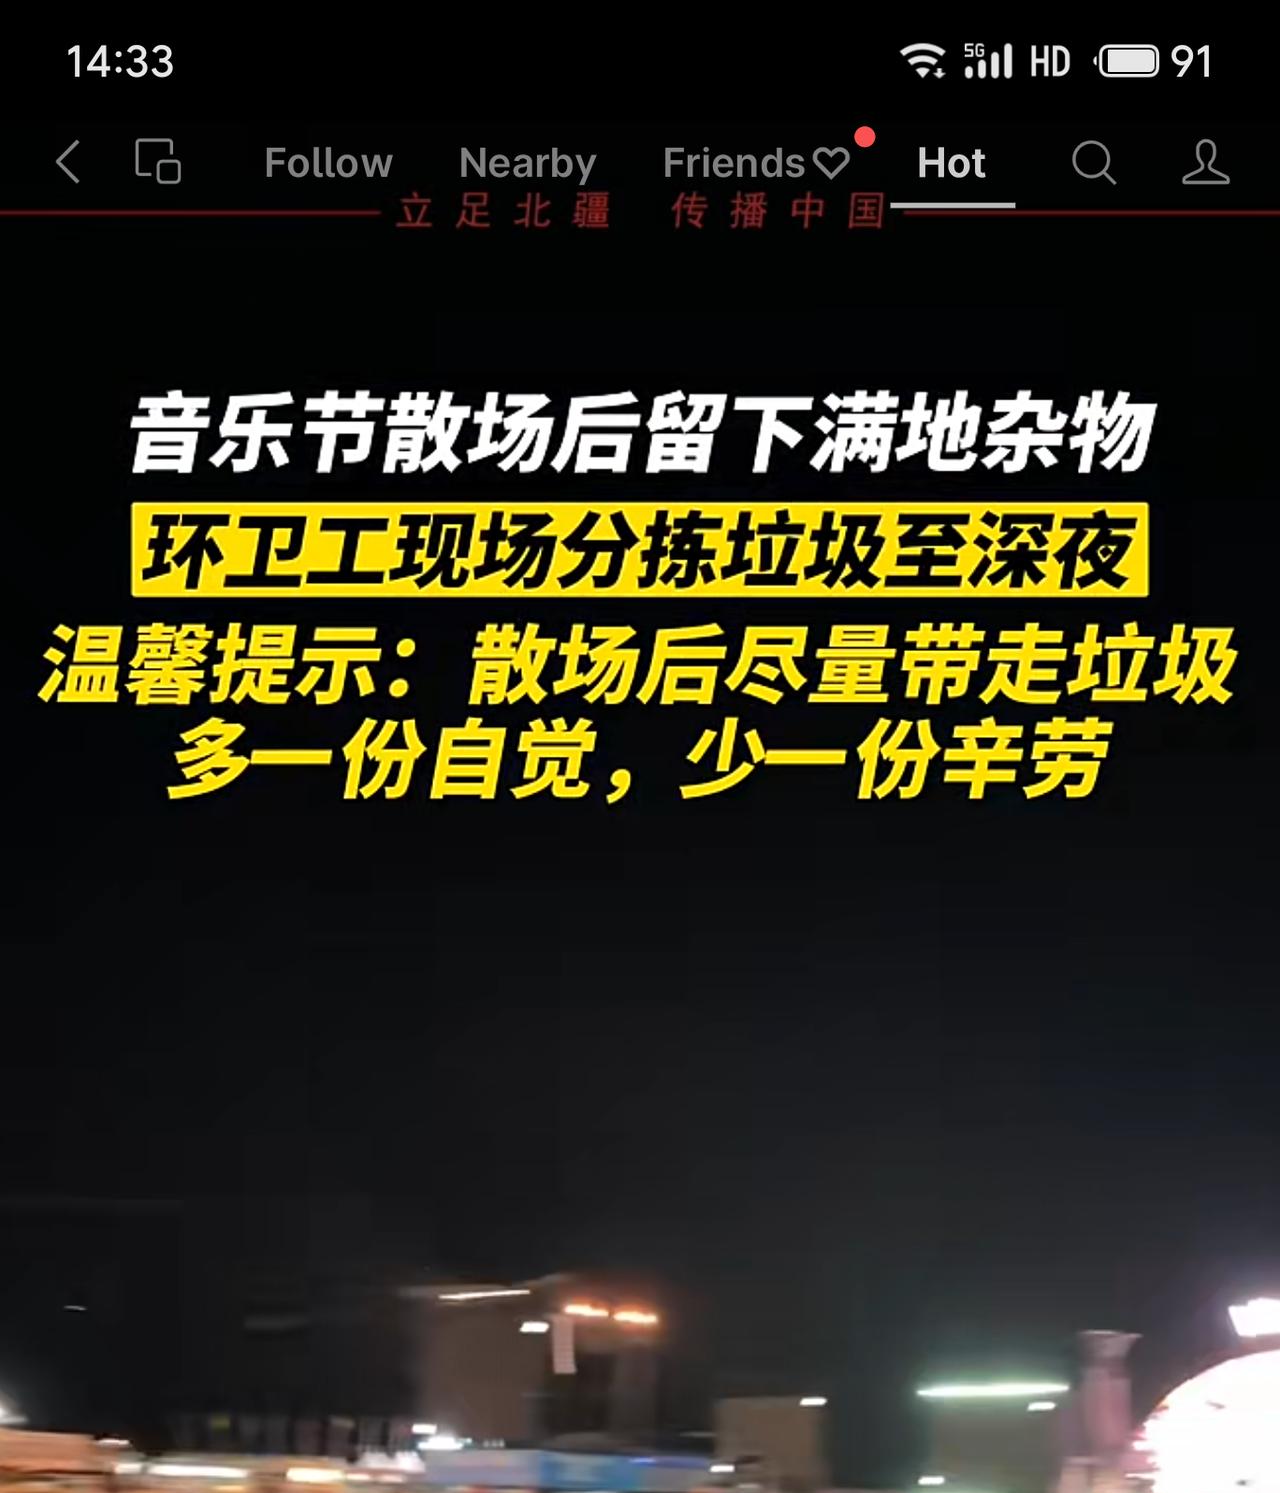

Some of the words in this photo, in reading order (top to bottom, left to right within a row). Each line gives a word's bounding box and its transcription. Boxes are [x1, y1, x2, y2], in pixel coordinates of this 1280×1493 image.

[67, 44, 174, 78] 14:33
[964, 42, 985, 58] 5G
[1030, 44, 1071, 77] HD
[1171, 44, 1210, 78] 91
[266, 146, 394, 178] Follow
[460, 147, 597, 186] Nearby
[664, 146, 806, 178] Friends
[919, 146, 986, 179] Hot
